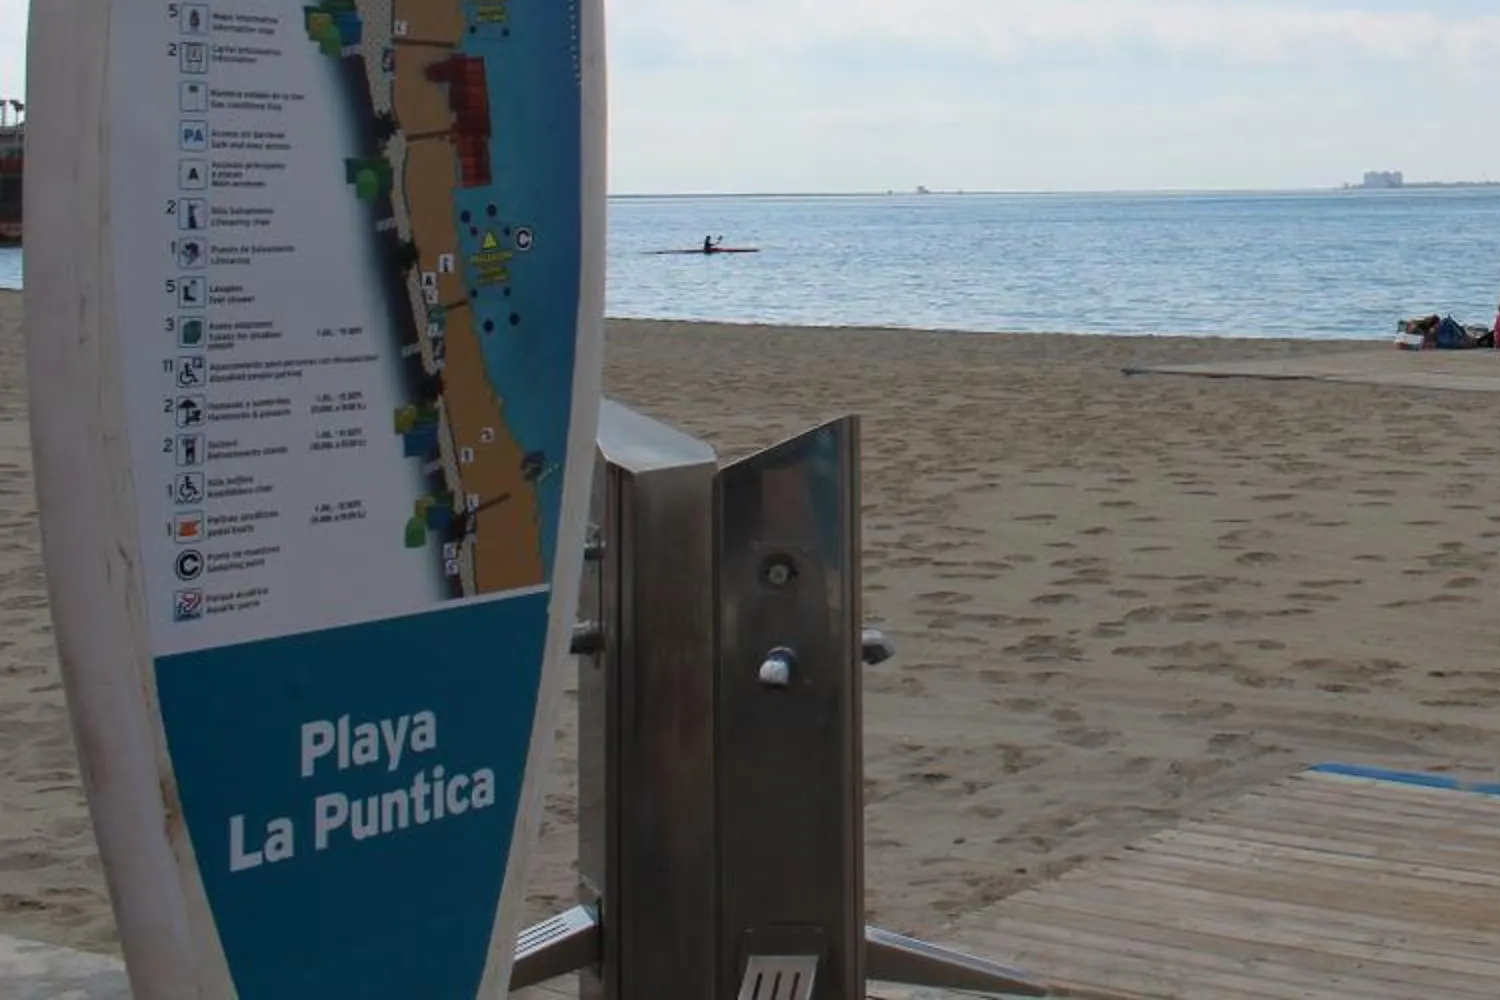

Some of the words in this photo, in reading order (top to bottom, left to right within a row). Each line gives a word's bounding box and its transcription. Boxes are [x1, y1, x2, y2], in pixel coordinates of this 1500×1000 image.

[168, 3, 179, 18] 5
[167, 43, 177, 57] 2
[183, 128, 204, 143] PA
[188, 167, 199, 181] A
[164, 200, 177, 215] 2
[165, 280, 176, 293] 5
[165, 318, 174, 332] 3
[162, 359, 173, 373] 11
[163, 398, 174, 413] 2
[163, 439, 173, 453] 2
[301, 709, 437, 778] Playa
[229, 813, 294, 873] La
[314, 764, 495, 851] Puntica
